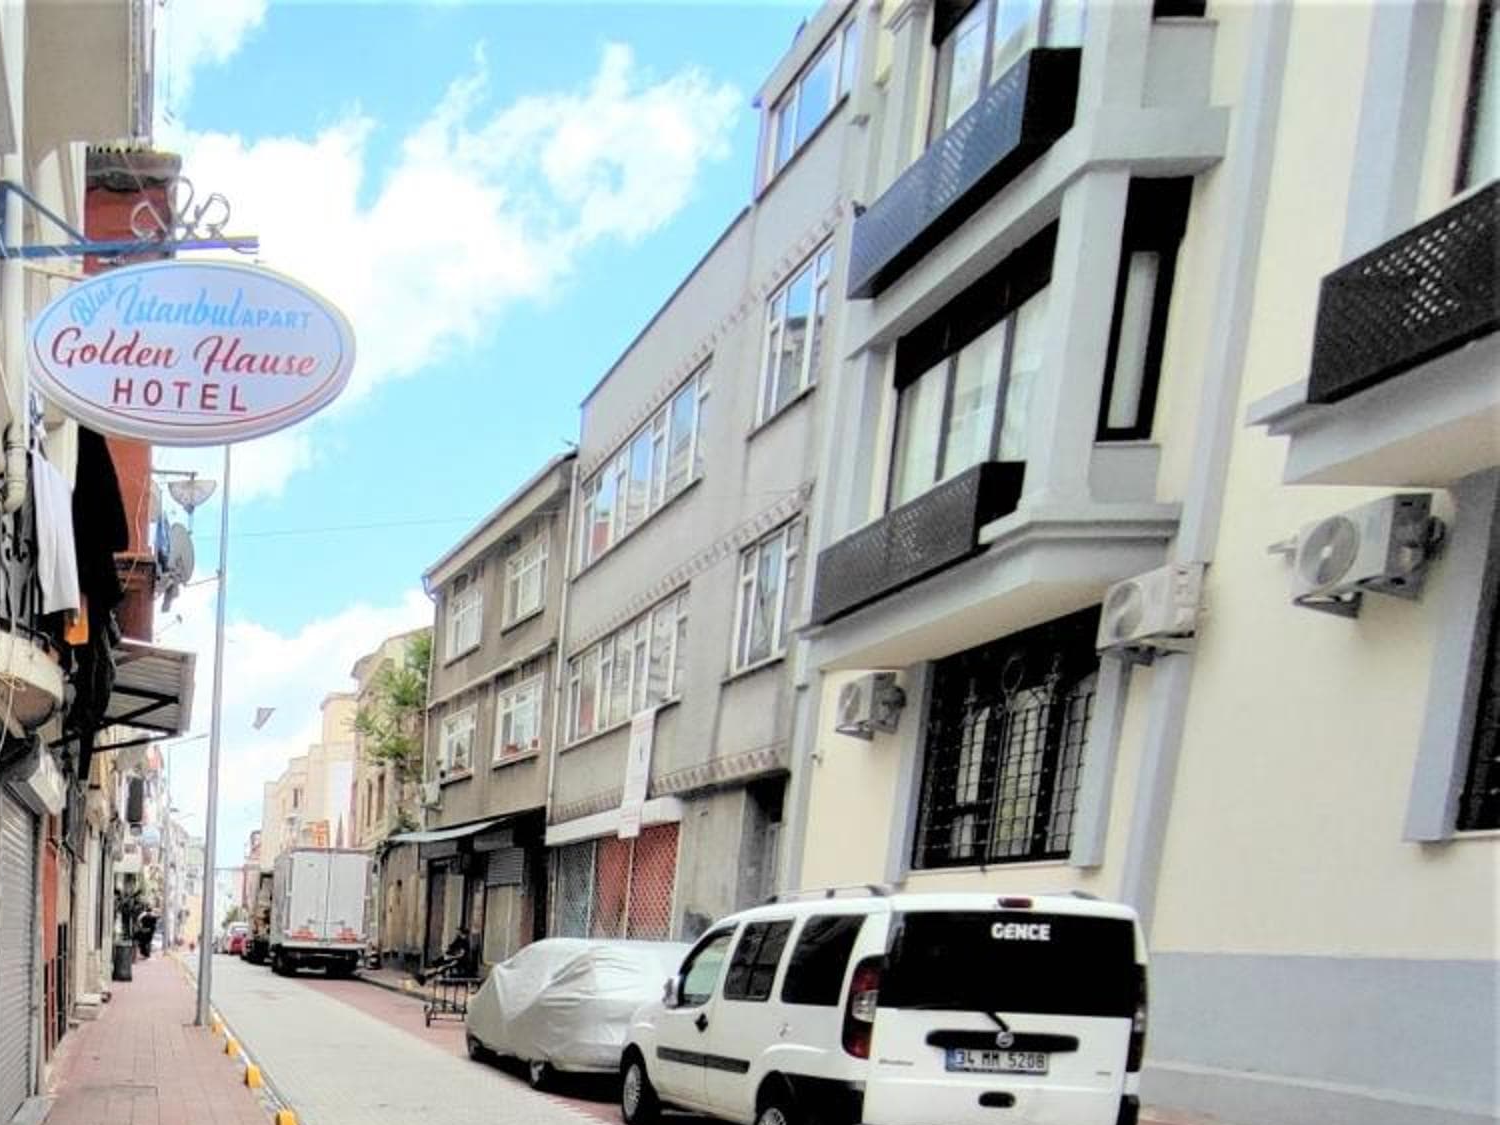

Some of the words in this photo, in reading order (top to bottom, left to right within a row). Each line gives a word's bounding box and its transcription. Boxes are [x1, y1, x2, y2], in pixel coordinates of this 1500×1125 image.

[243, 309, 314, 330] APART
[51, 327, 180, 369] Golden
[193, 335, 321, 376] Hause
[112, 377, 248, 412] HOTEL
[991, 923, 1051, 941] GENCE
[956, 1051, 974, 1065] 34
